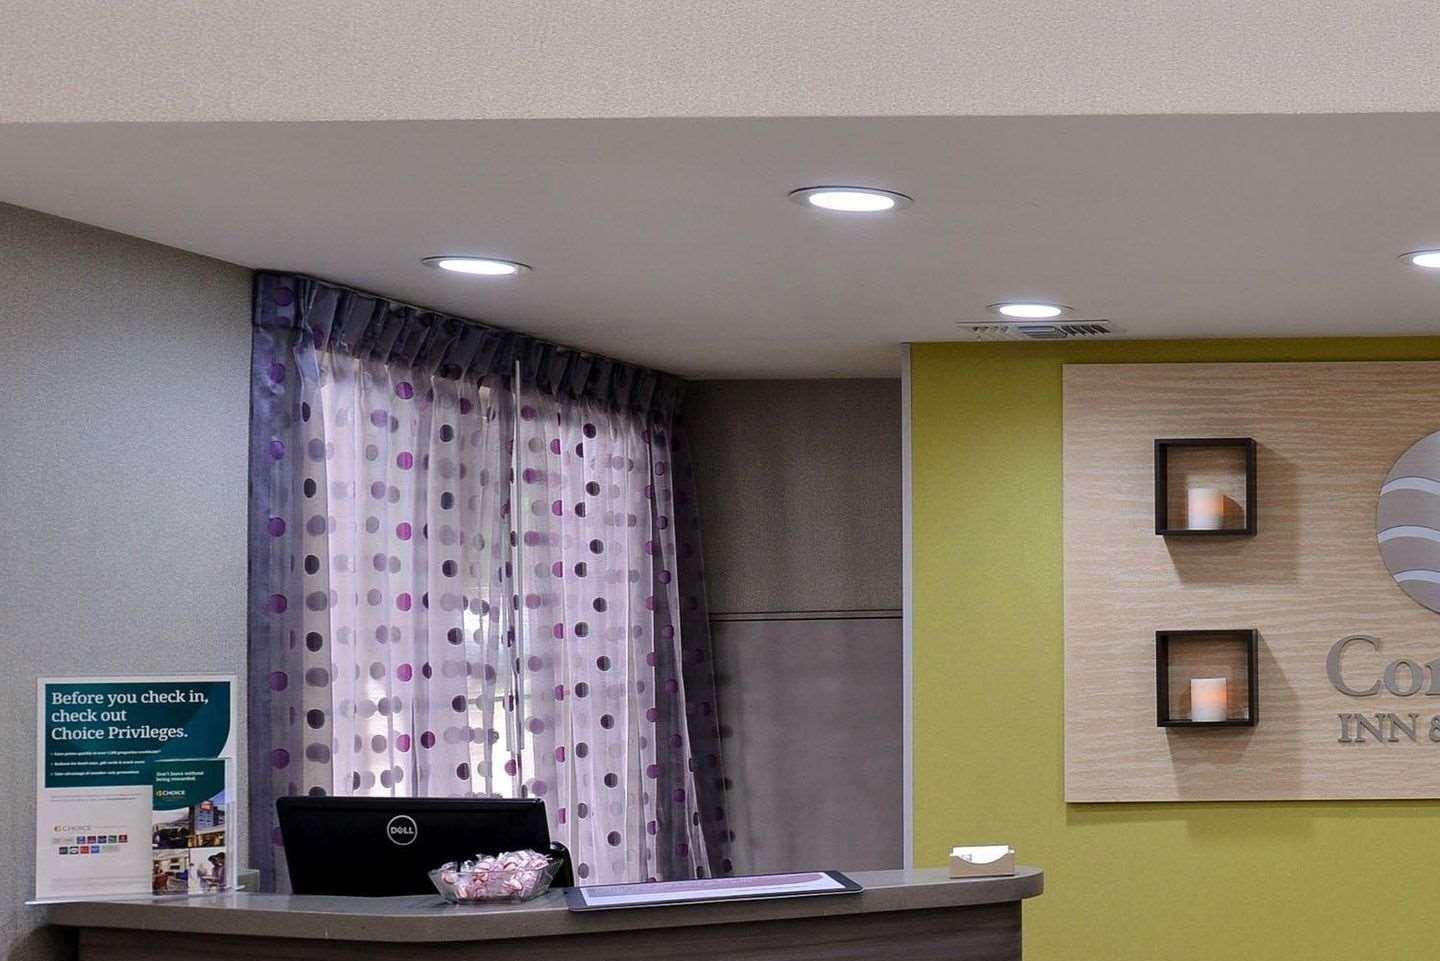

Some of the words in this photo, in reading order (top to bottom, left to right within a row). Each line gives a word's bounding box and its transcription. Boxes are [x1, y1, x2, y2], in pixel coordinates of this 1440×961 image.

[52, 691, 104, 705] Before
[107, 694, 137, 708] you
[140, 690, 186, 703] check
[189, 689, 209, 704] in,
[51, 709, 97, 722] check
[100, 710, 127, 722] out
[51, 727, 105, 740] Choice
[108, 726, 189, 742] Privileges.
[1337, 712, 1420, 743] INN
[390, 826, 415, 834] DELL
